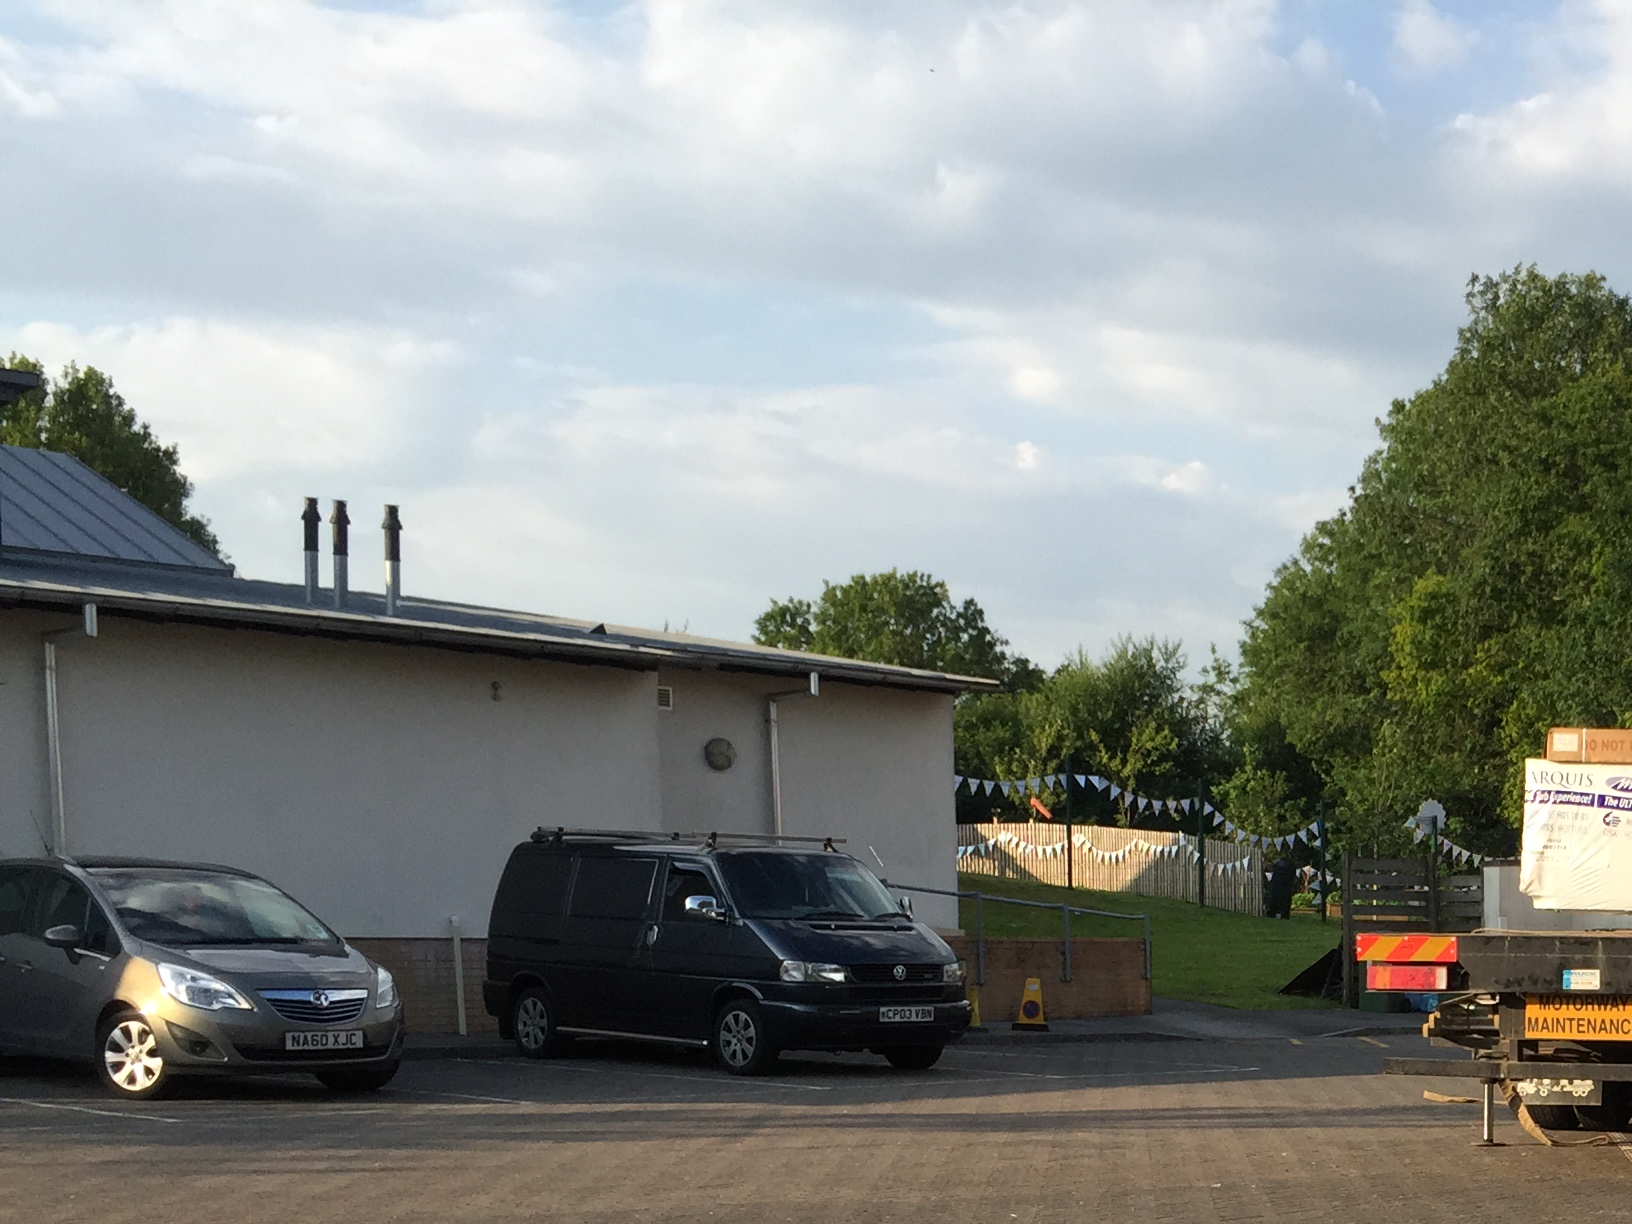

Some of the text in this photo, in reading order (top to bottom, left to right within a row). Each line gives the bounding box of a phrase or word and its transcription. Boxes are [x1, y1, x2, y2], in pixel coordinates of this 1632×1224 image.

[1601, 739, 1626, 751] NOT
[1550, 791, 1593, 804] Experience!
[1604, 796, 1619, 807] The
[1556, 810, 1570, 819] HOT
[1538, 993, 1629, 1012] MOTORWAY
[886, 1008, 932, 1020] CP03 VBN
[291, 1033, 357, 1047] NA60 XJC
